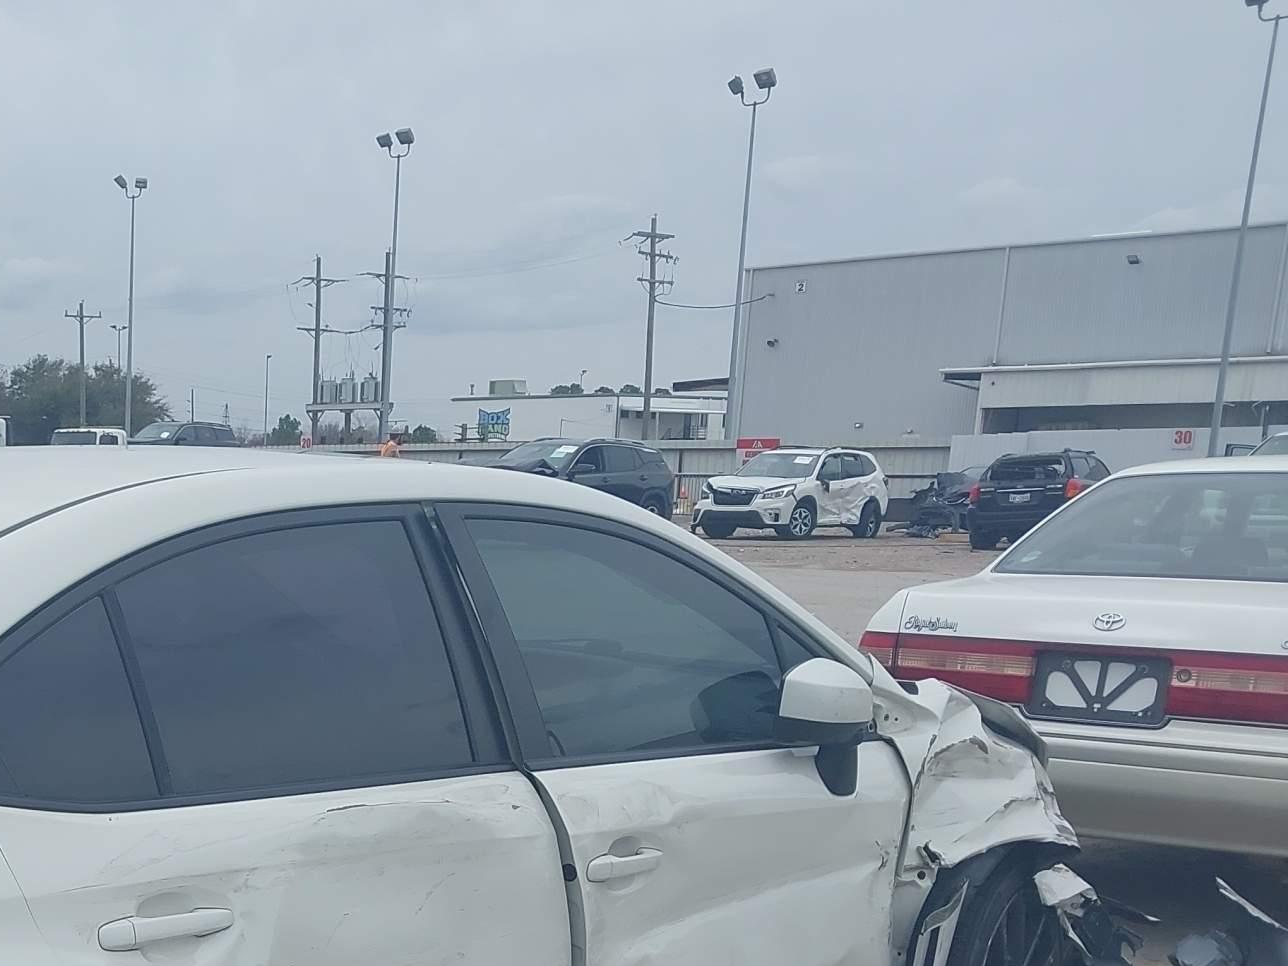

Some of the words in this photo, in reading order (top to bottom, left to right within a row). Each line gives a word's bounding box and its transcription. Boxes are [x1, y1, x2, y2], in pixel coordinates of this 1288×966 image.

[479, 407, 511, 425] BOX
[301, 437, 312, 449] 20
[1174, 430, 1192, 445] 30
